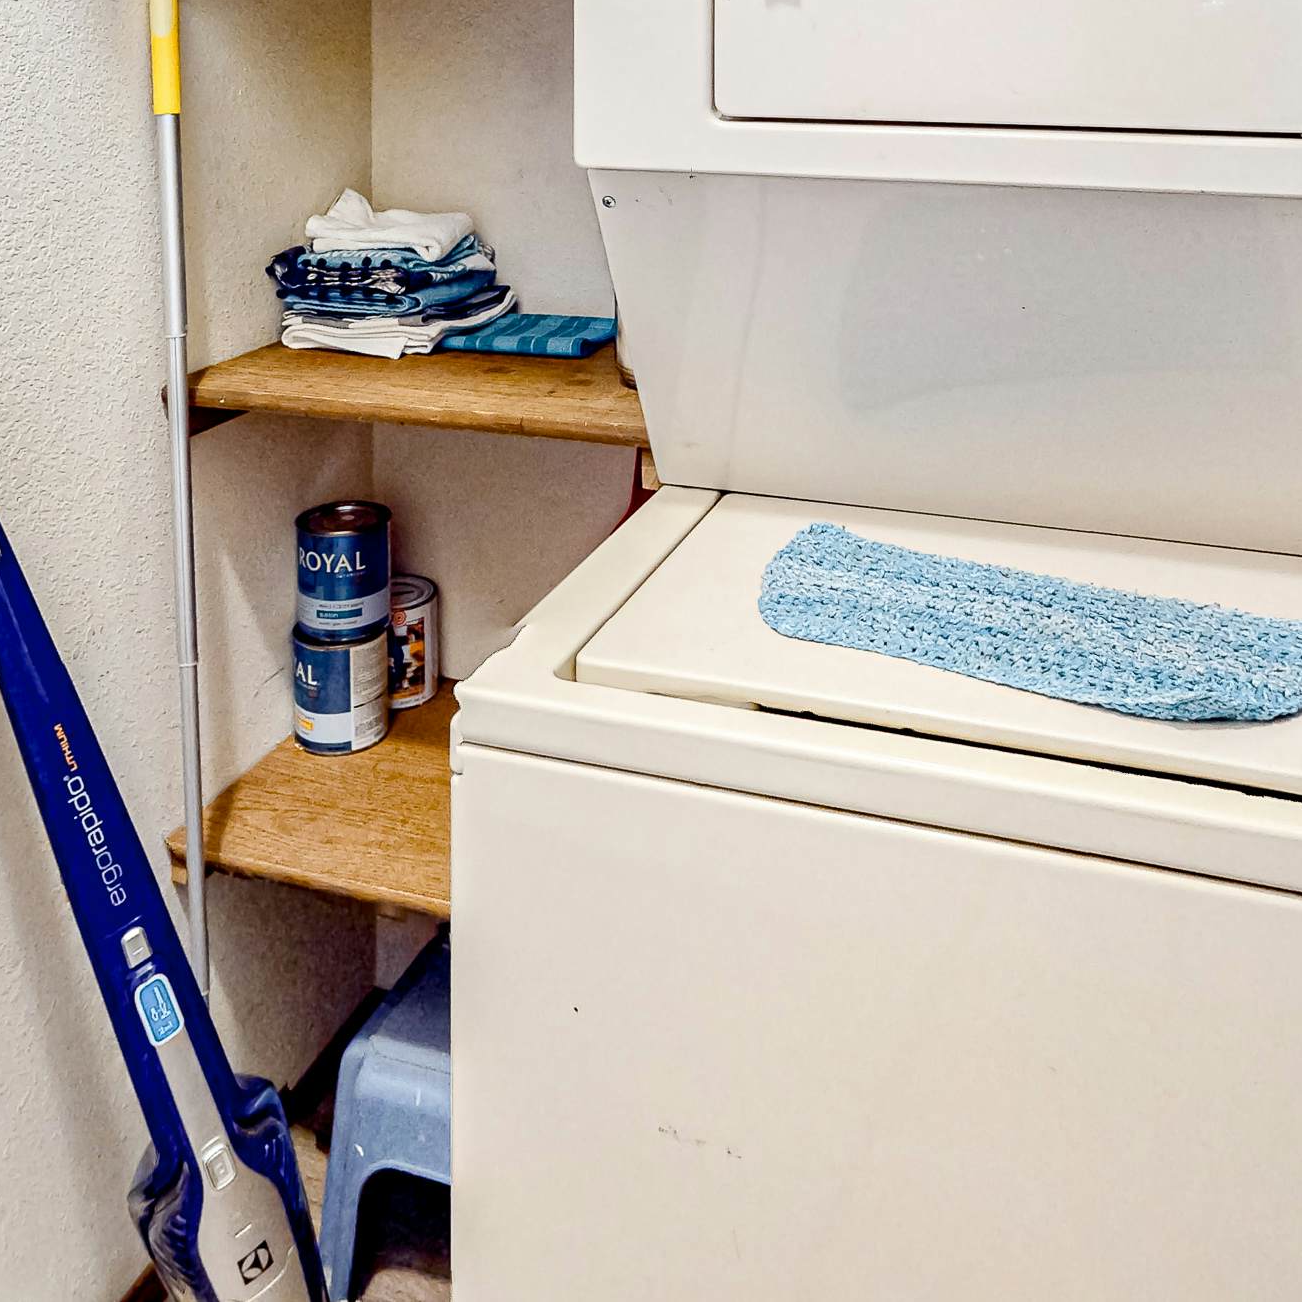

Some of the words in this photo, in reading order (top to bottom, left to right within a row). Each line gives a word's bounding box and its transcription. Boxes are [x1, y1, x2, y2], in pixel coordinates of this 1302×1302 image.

[299, 546, 366, 574] ROYAL
[294, 658, 319, 686] AL
[53, 722, 79, 772] LITHIUM
[65, 775, 128, 906] ergorapido
